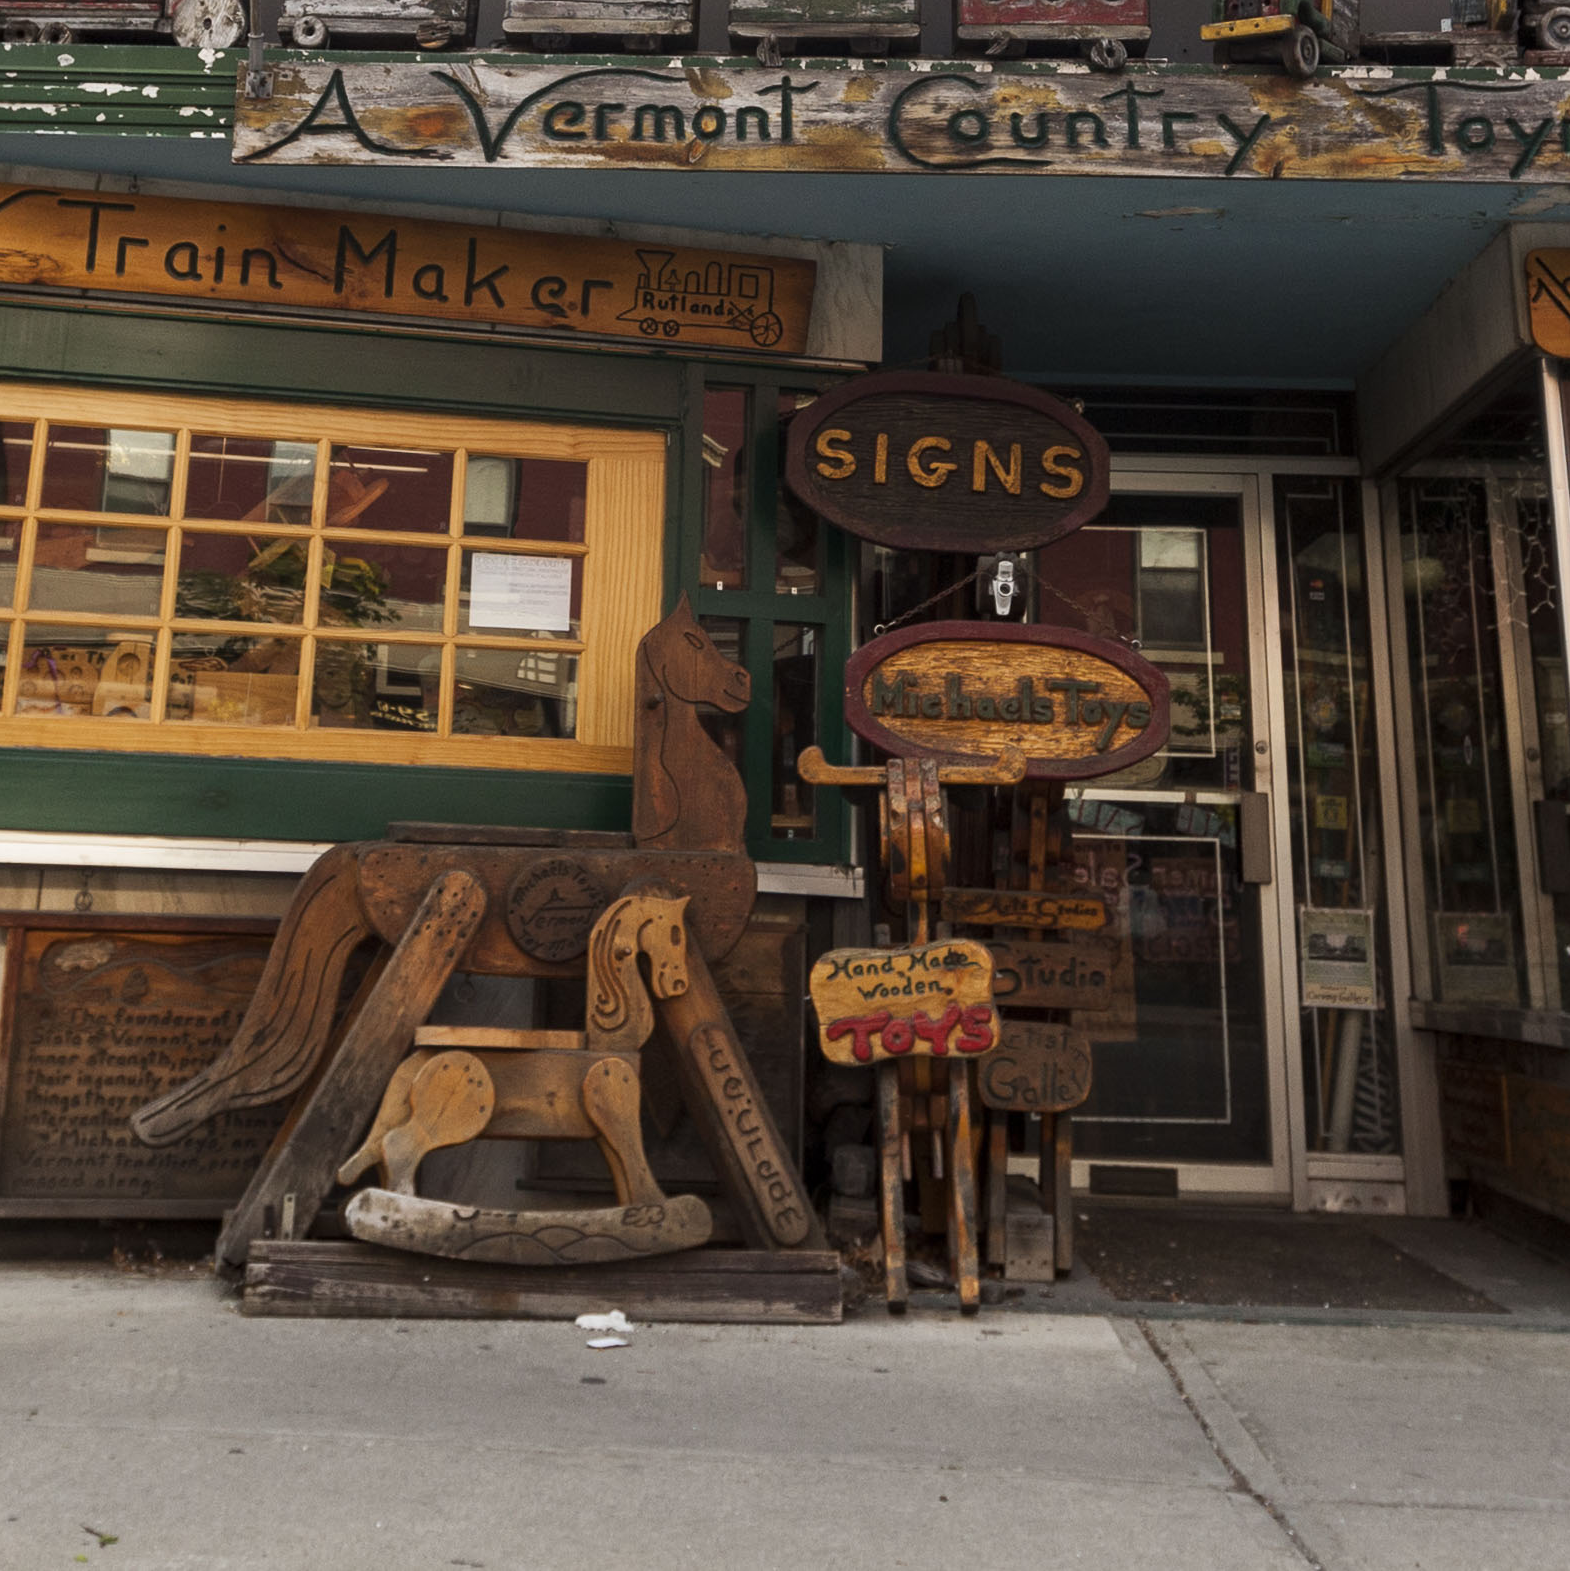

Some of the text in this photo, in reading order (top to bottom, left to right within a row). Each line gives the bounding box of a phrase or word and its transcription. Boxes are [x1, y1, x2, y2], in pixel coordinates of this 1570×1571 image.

[240, 67, 453, 161] A
[429, 67, 822, 162] Vermont
[886, 73, 1274, 176] Country
[55, 196, 284, 292] Train
[333, 222, 617, 319] Maker
[641, 290, 730, 317] Rutland
[814, 428, 1085, 500] SIGNS
[870, 670, 1152, 753] Michaels Toys
[825, 947, 984, 981] Hand Made
